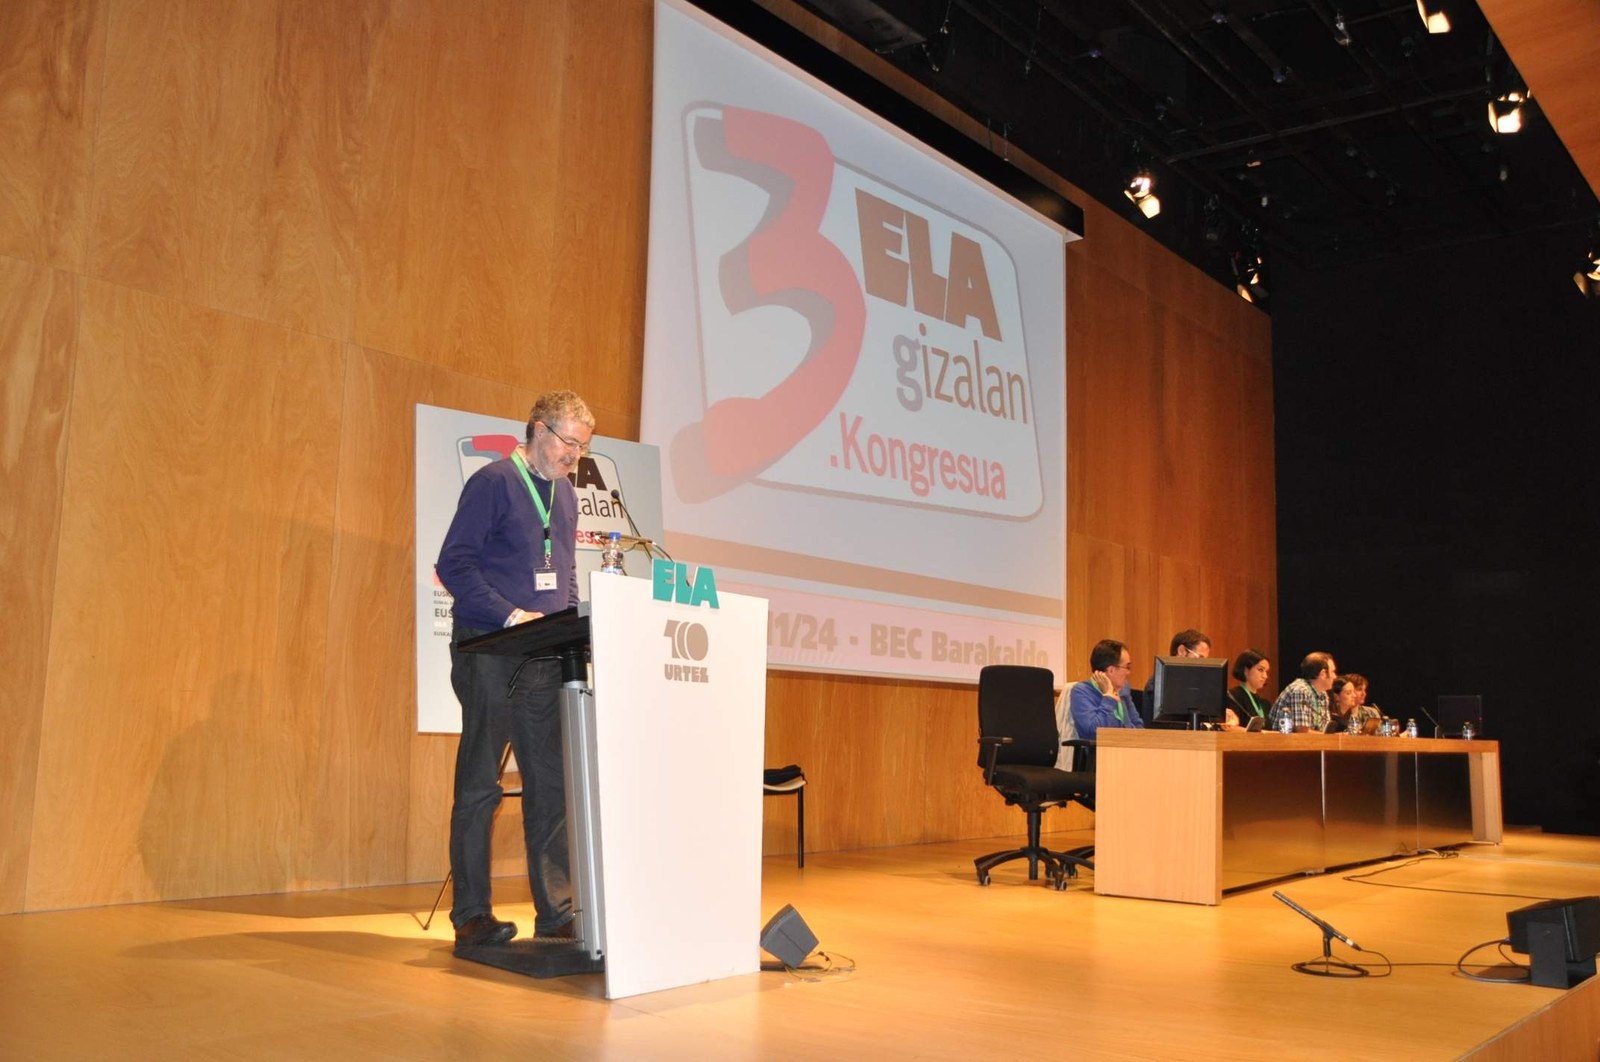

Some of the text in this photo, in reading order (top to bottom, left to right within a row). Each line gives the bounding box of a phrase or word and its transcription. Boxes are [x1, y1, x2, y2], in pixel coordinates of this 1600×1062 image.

[855, 187, 1003, 342] ELA
[893, 322, 1028, 424] gizalan
[652, 558, 720, 609] ELA
[870, 623, 922, 660] BEC
[931, 631, 1049, 667] Barakaldo
